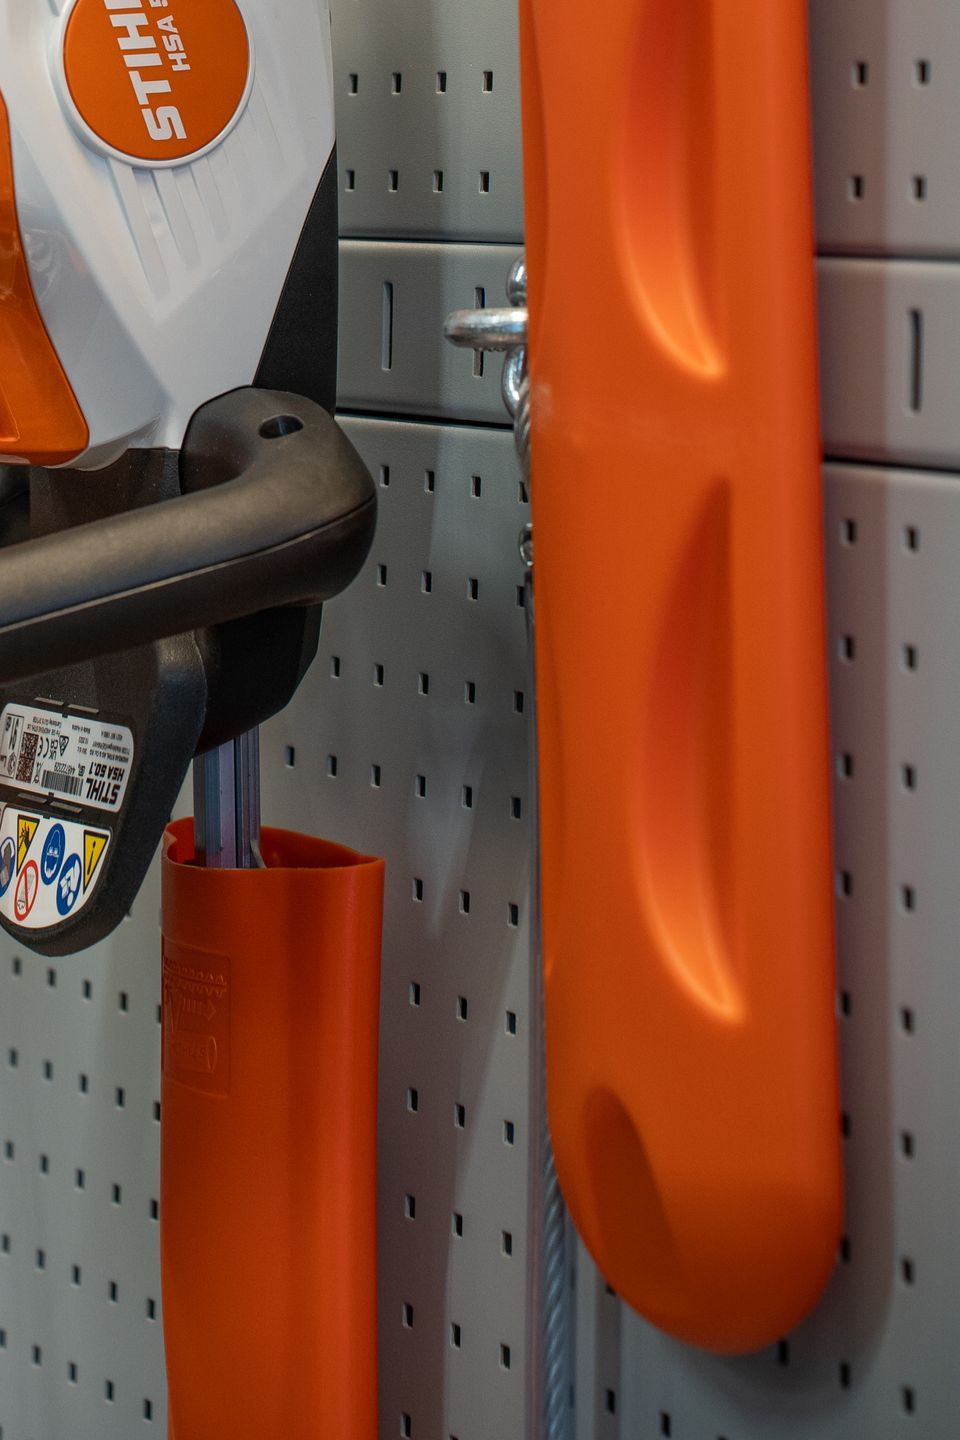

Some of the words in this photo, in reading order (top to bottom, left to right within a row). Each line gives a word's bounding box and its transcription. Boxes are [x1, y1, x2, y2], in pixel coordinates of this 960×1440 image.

[157, 14, 191, 71] HSA
[107, 765, 125, 782] HSA
[86, 777, 121, 805] STIHL
